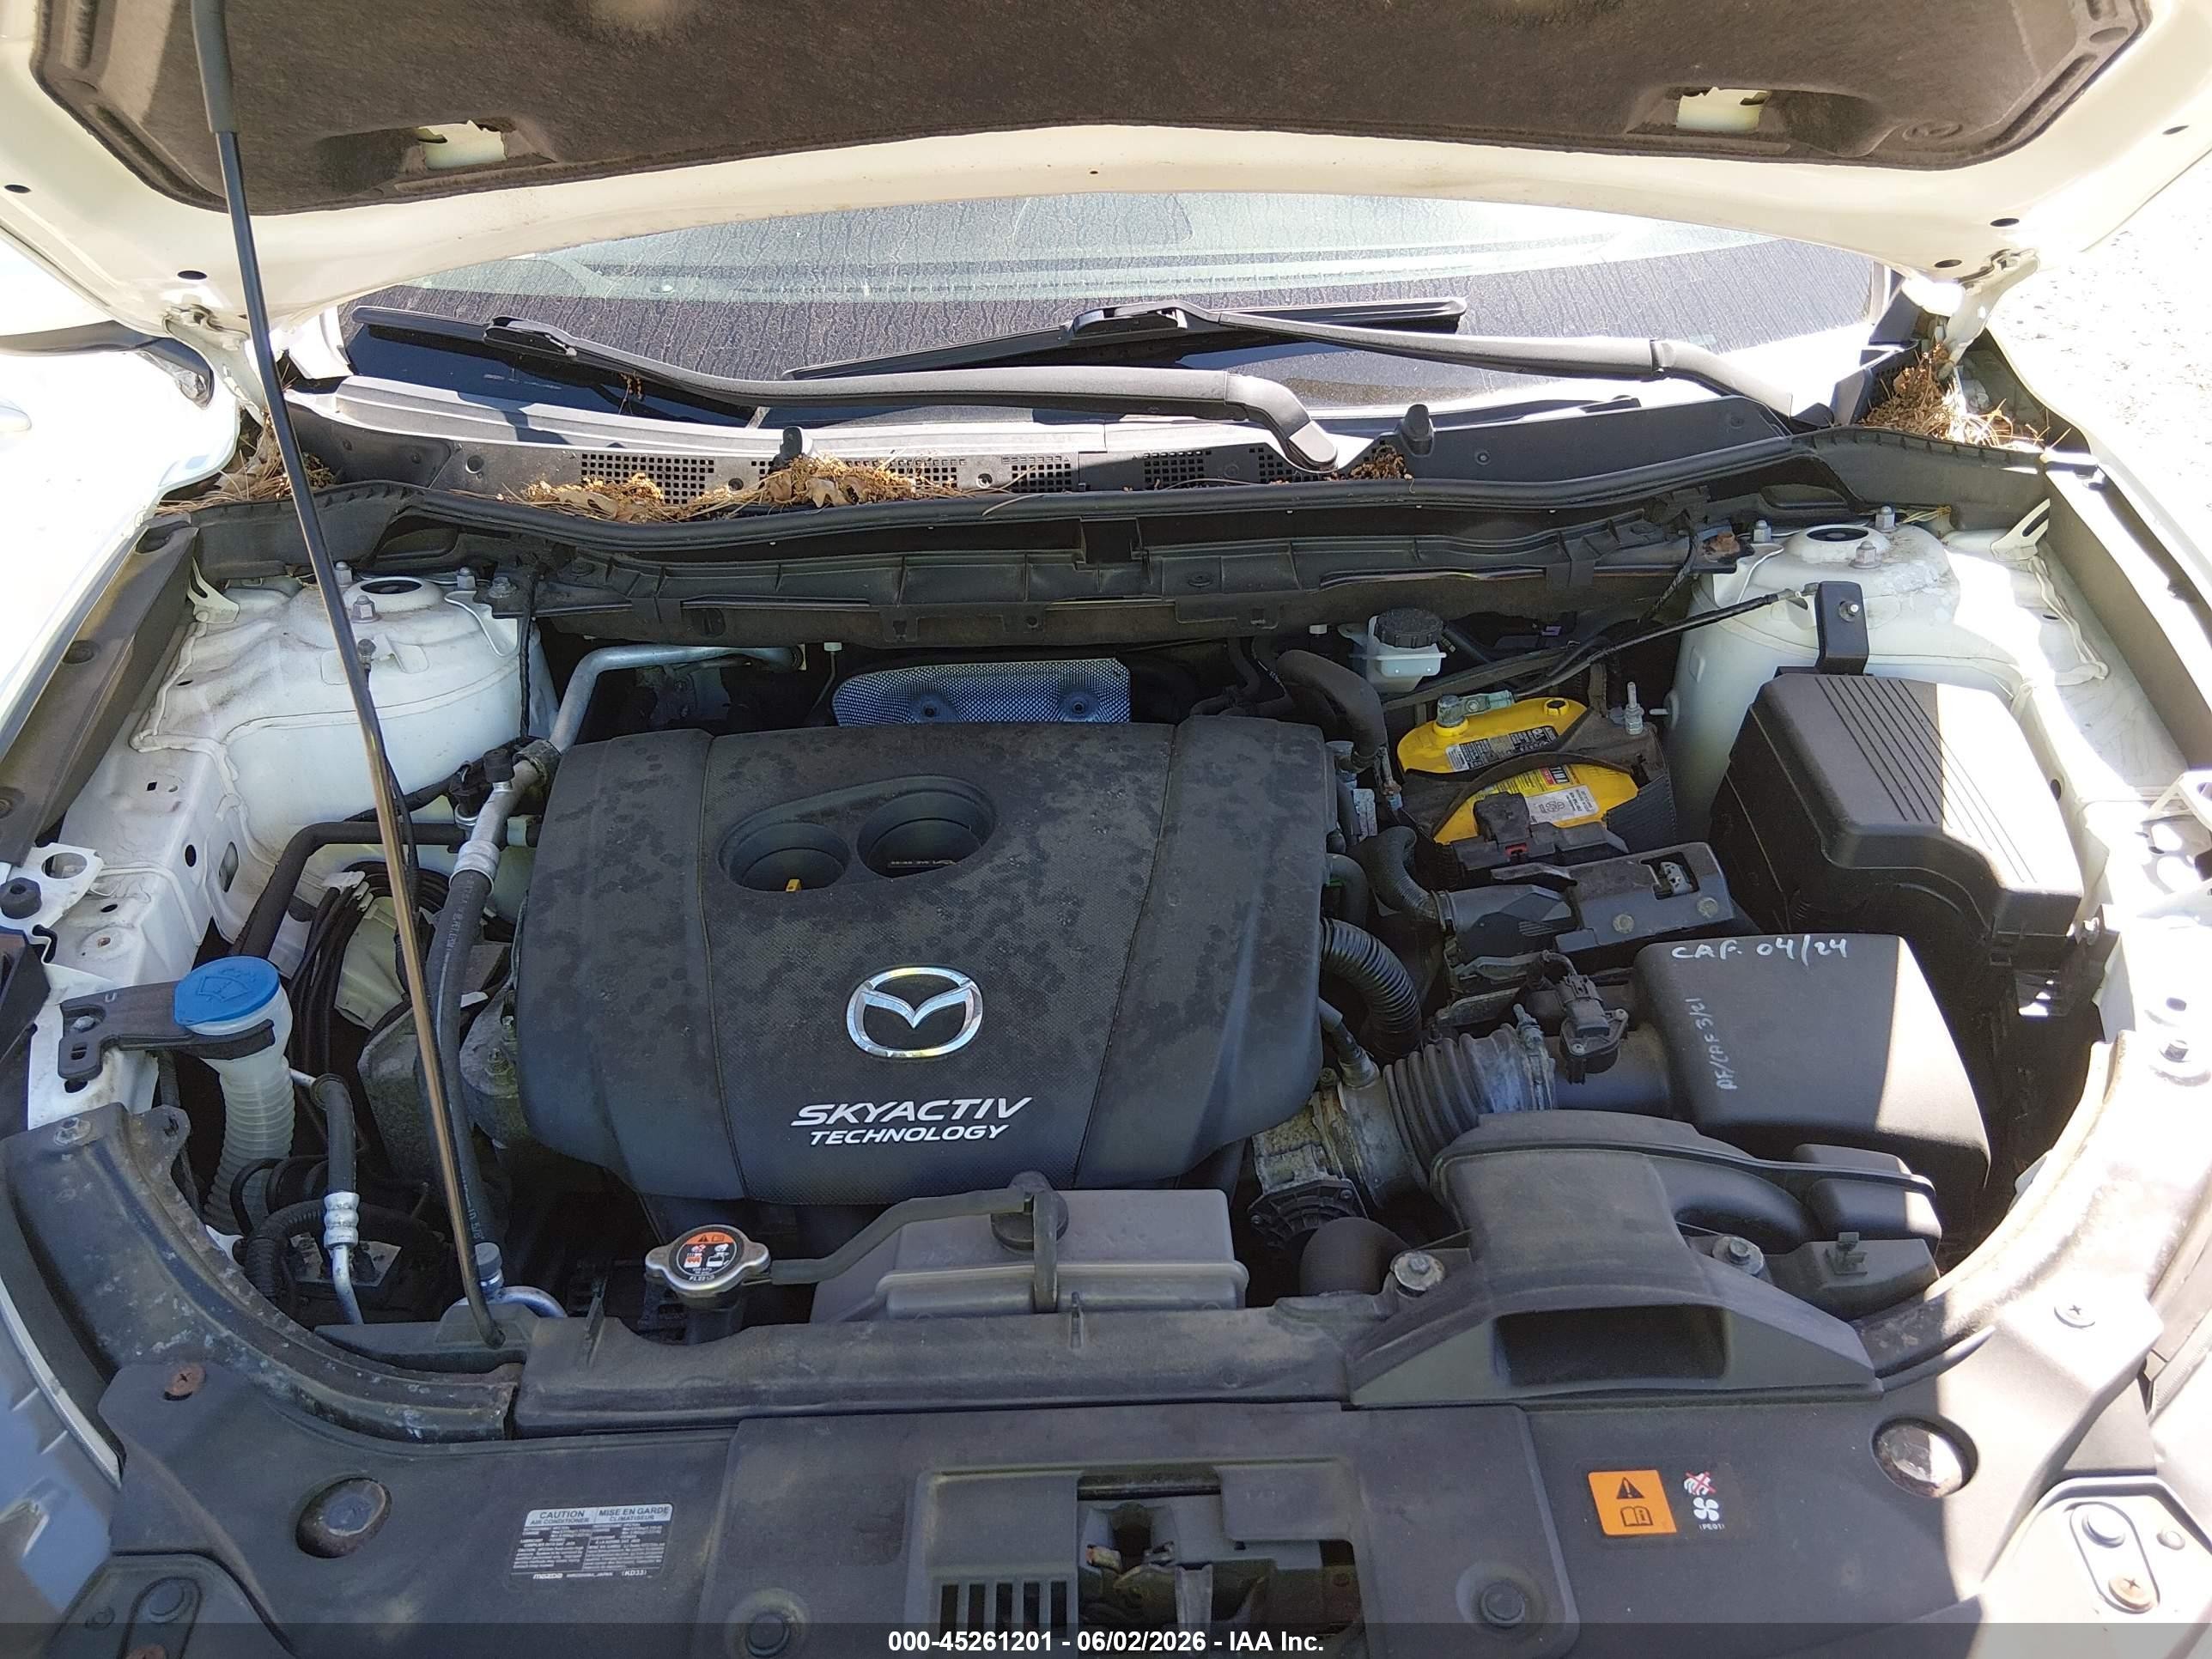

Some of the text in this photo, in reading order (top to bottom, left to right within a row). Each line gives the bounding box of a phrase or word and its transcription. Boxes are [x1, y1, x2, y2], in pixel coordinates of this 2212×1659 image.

[1756, 934, 1848, 968] 04/24
[790, 1097, 1033, 1127] SKYACTIV
[810, 1124, 1010, 1146] TECHNOLOGY
[539, 1510, 585, 1519] CAUTION
